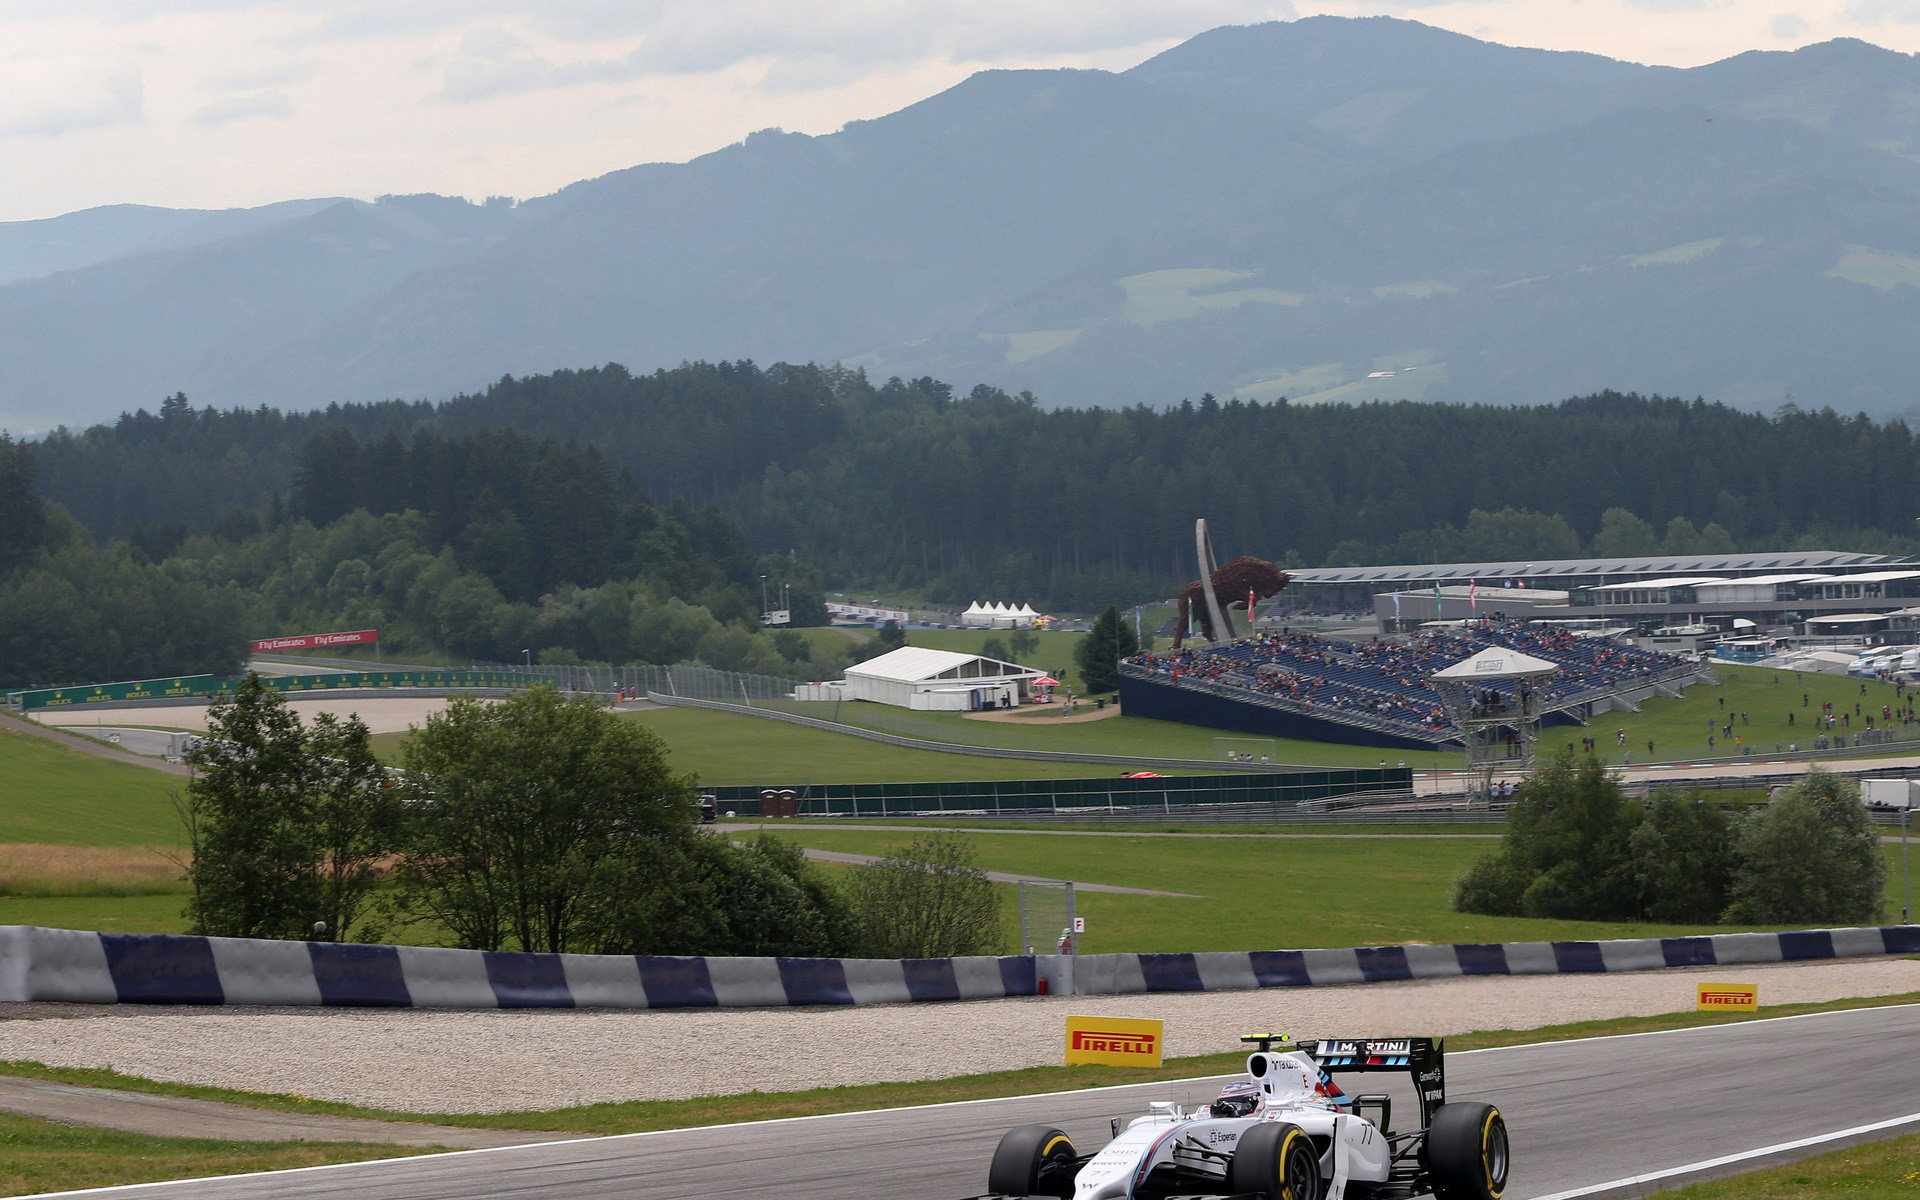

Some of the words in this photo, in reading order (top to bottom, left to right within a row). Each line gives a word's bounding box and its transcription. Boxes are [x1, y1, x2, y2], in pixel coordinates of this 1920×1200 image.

[258, 641, 272, 650] Fly
[273, 639, 306, 648] Emirates
[314, 636, 328, 645] Fly
[328, 633, 361, 643] Emirates
[126, 690, 152, 699] ROLEX
[165, 687, 191, 695] ROLEX
[46, 698, 72, 706] ROLEX
[86, 694, 112, 702] ROLEX
[1075, 920, 1082, 930] F
[1701, 992, 1753, 1005] PIRELLI
[1072, 1031, 1155, 1054] PIRELLI
[1218, 1131, 1237, 1143] Experian
[1360, 1123, 1373, 1145] 77
